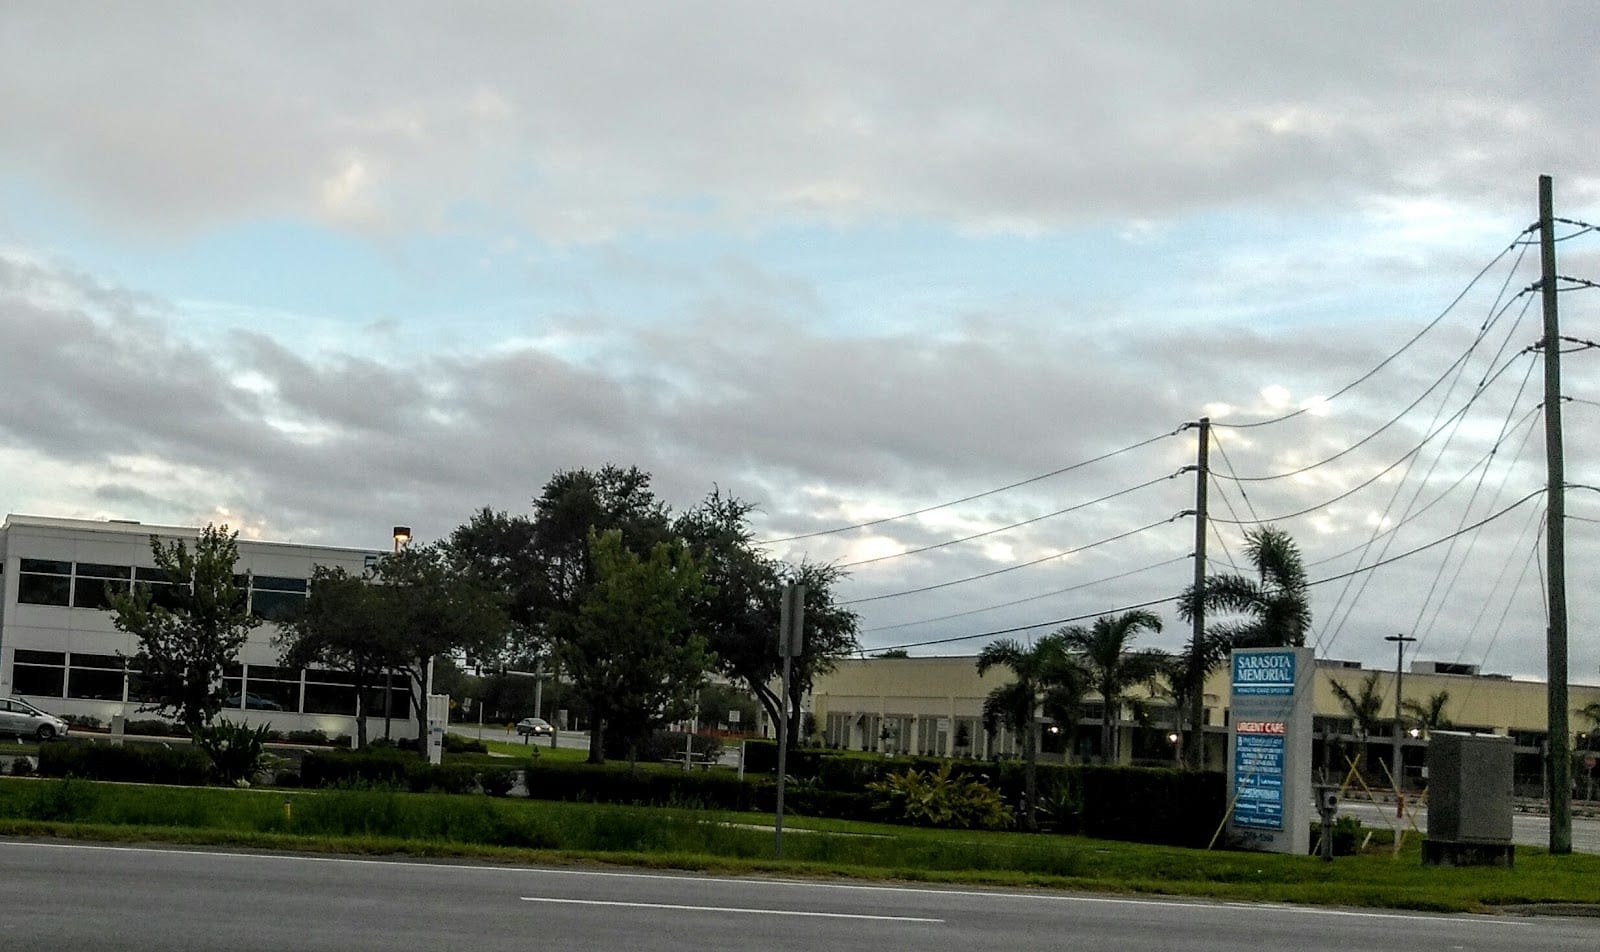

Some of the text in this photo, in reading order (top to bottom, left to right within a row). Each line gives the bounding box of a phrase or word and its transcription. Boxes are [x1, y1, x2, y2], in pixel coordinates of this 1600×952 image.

[1238, 655, 1291, 669] SARASOTA
[1238, 668, 1291, 681] MEMORIAL
[1237, 722, 1285, 733] URGENT CARE
